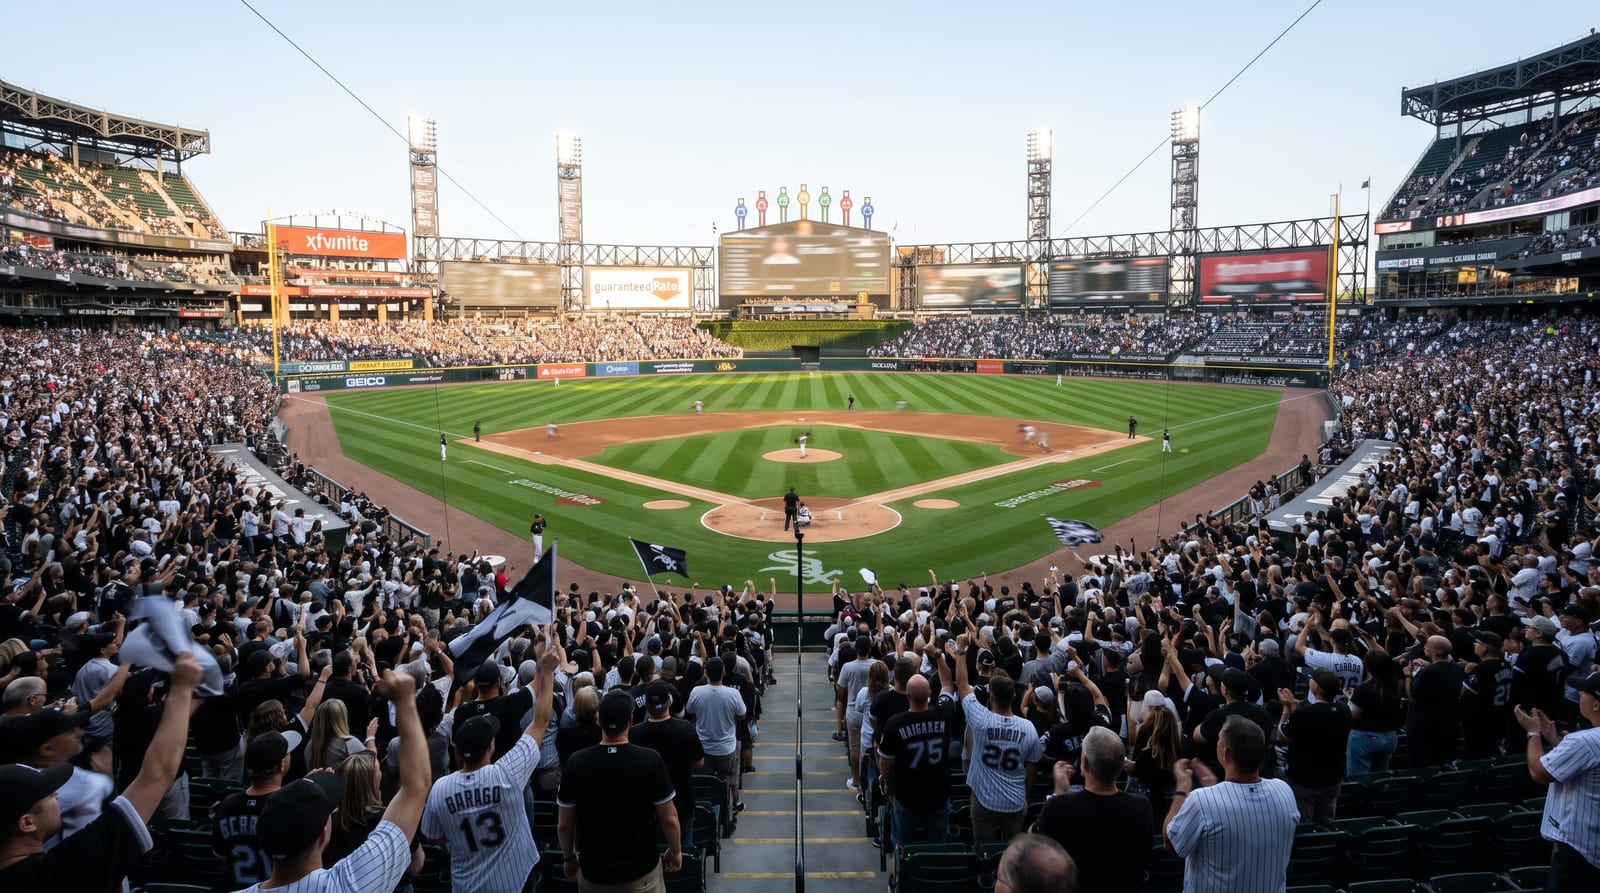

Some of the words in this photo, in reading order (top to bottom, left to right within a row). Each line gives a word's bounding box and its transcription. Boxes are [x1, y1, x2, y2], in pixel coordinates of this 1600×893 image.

[594, 282, 652, 294] guaranteed
[653, 280, 678, 292] Rate
[346, 376, 385, 387] GEICO
[907, 738, 943, 769] 75
[981, 745, 1020, 770] 26
[445, 786, 500, 814] BARAGO
[460, 811, 504, 852] 13
